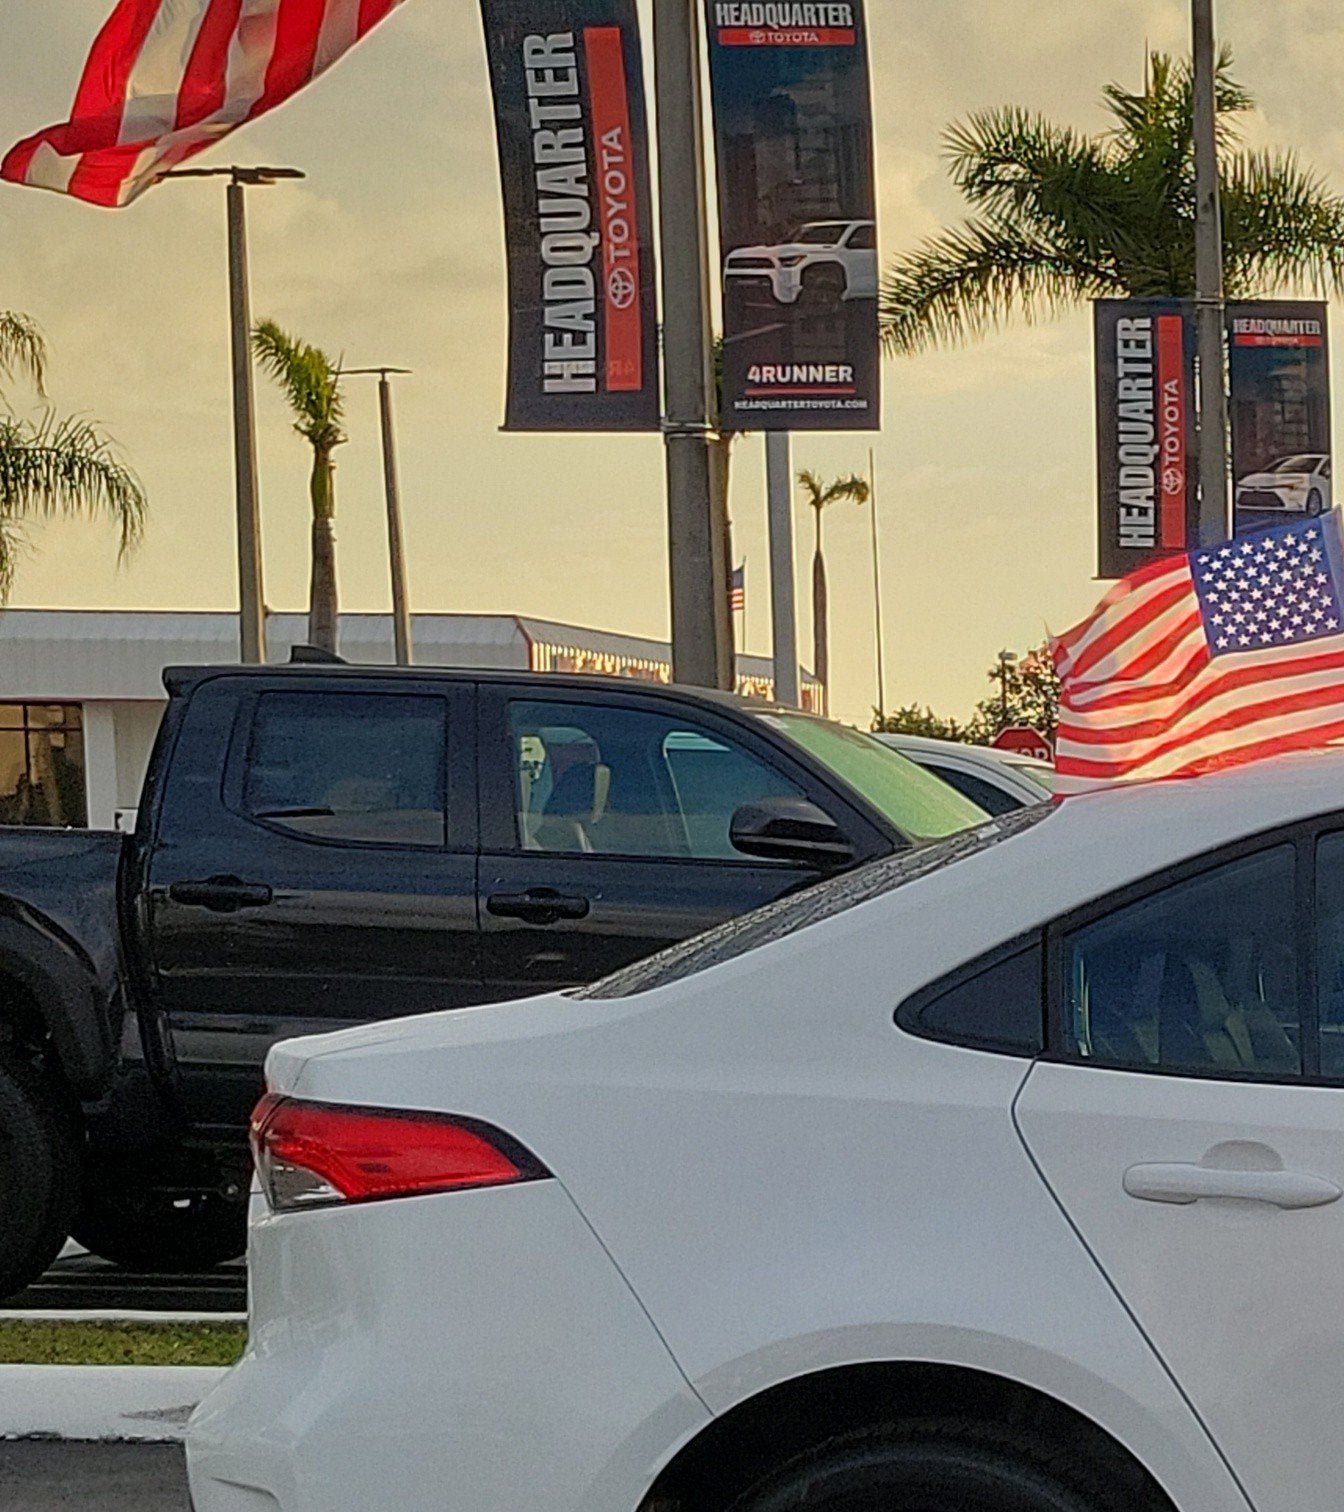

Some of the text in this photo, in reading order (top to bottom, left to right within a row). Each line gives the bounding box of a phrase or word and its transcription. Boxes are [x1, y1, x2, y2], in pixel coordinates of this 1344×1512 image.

[715, 3, 853, 29] HEADQUARTER
[767, 31, 818, 43] TOYOTA
[523, 31, 599, 394] HEADQUARTER
[600, 126, 632, 262] TOYOTA
[747, 364, 853, 383] 4RUNNER
[1117, 317, 1159, 547] HEADQUARTER
[1164, 379, 1180, 464] TOYOTA
